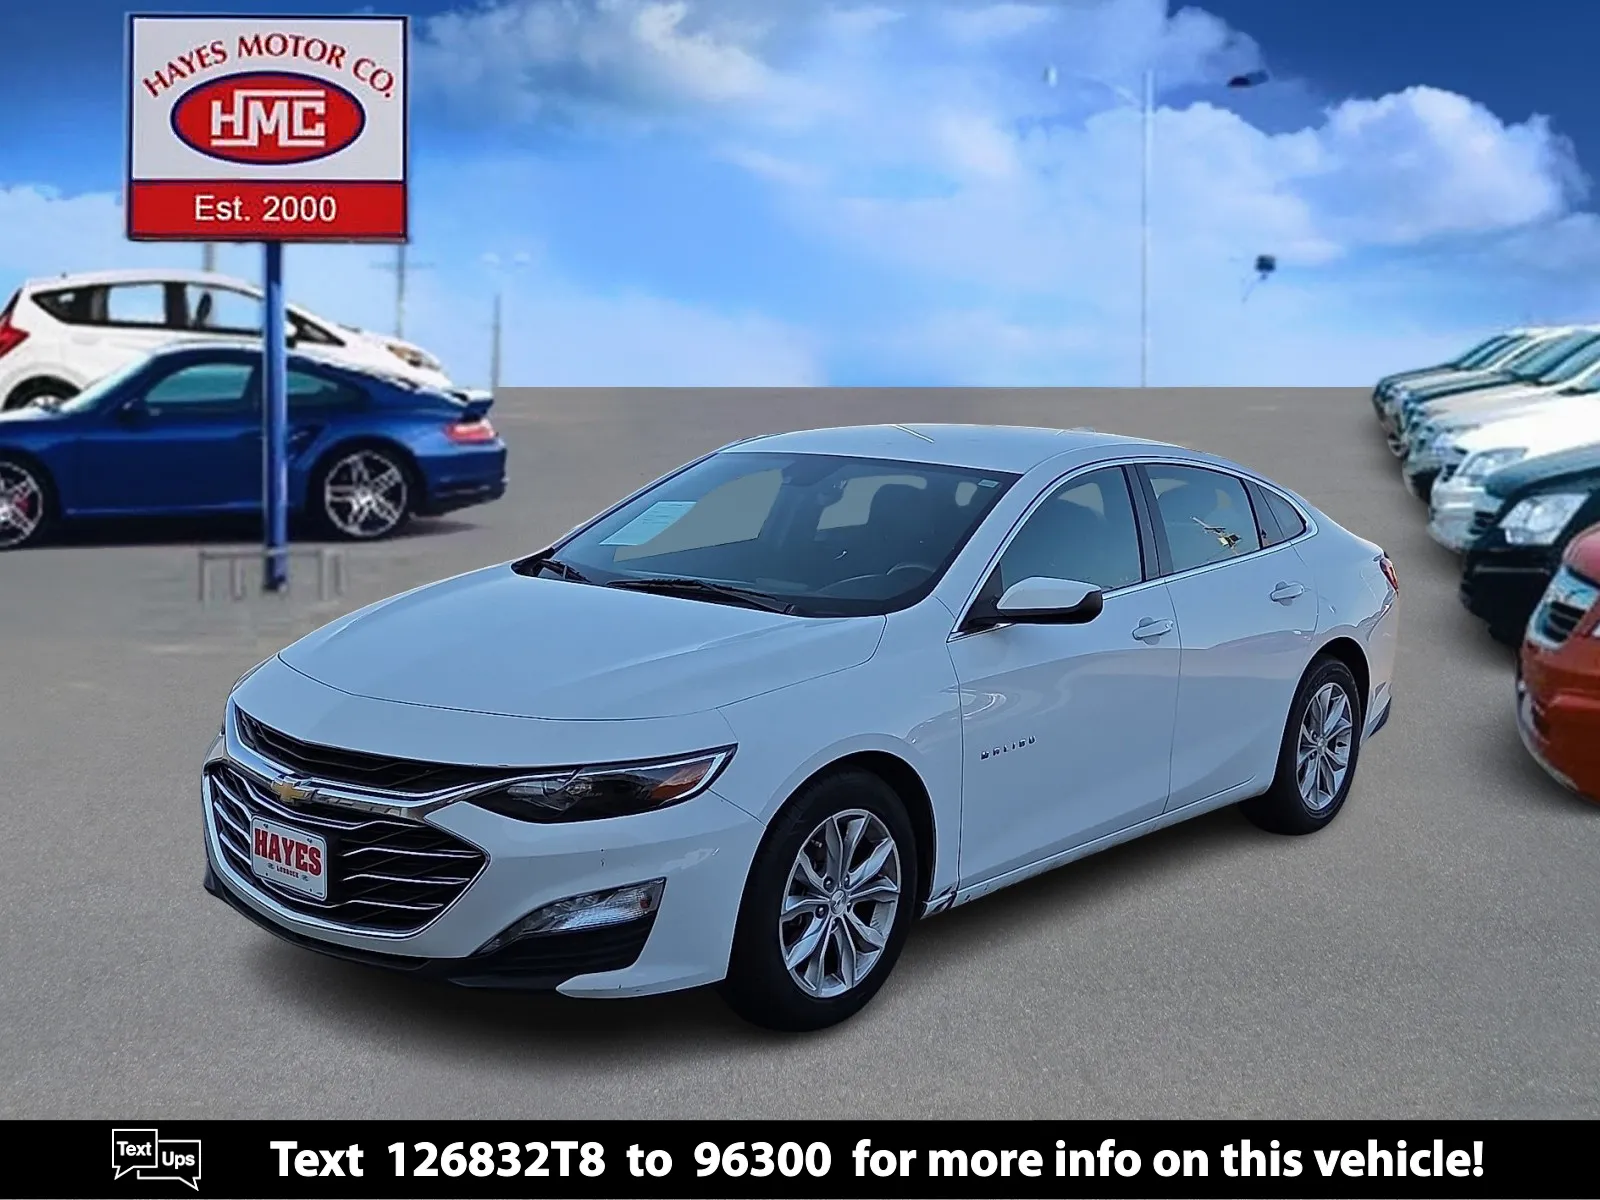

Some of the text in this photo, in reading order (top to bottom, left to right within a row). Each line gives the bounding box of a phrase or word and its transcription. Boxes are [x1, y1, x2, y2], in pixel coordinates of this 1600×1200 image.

[143, 33, 395, 98] HAYES MOTOR CO.
[210, 89, 326, 147] HMC
[195, 194, 337, 222] Est. 2000
[254, 828, 322, 876] HAYES
